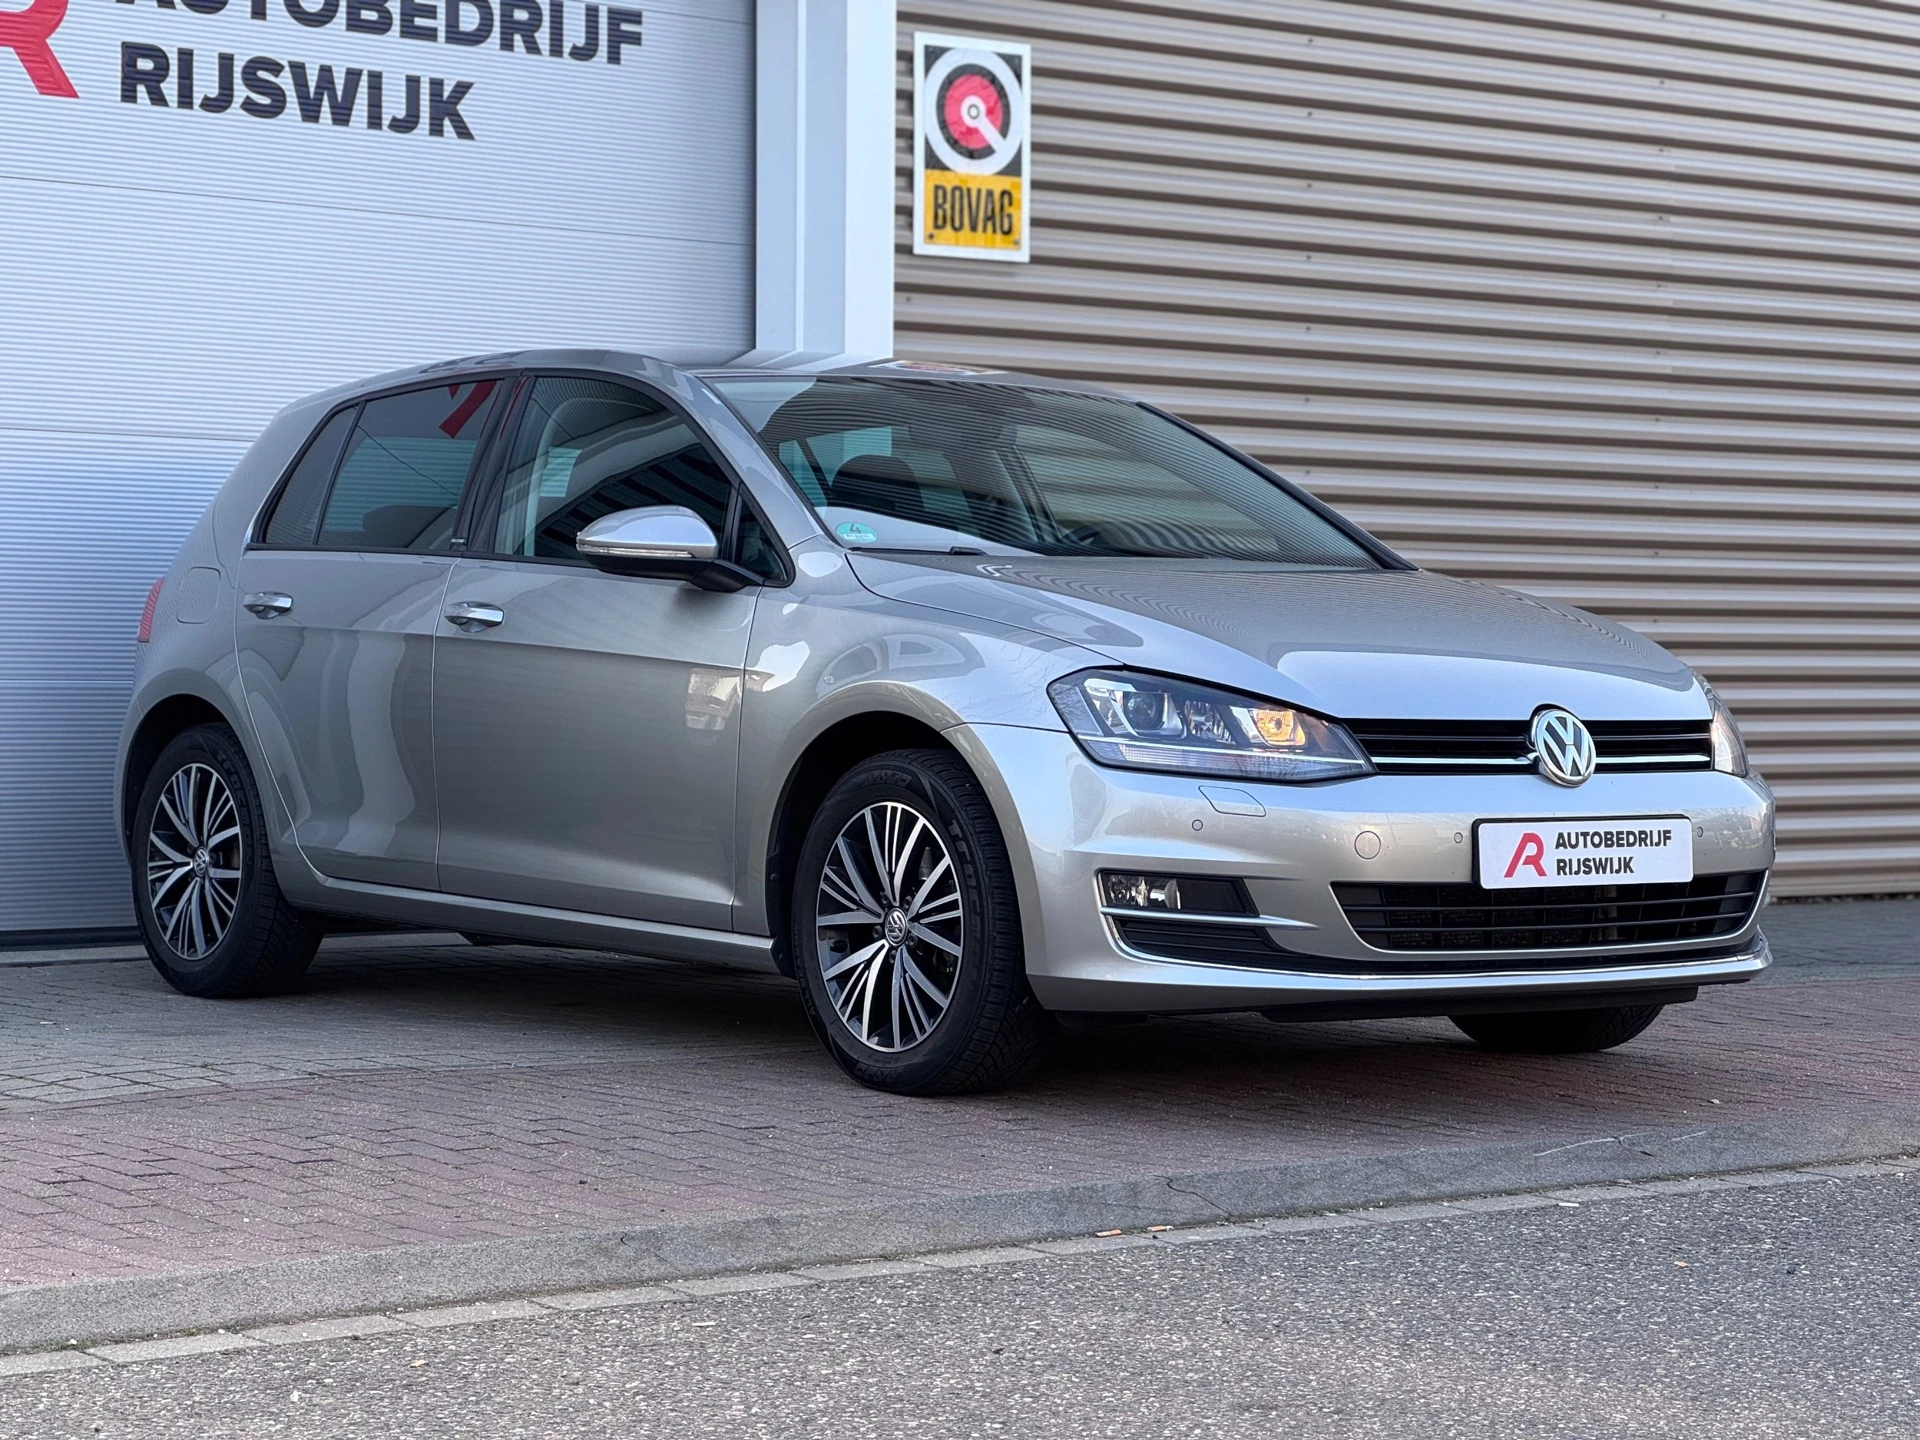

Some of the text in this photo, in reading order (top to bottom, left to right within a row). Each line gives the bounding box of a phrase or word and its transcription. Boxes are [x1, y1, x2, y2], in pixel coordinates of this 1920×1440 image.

[115, 0, 642, 65] BEDRIJF
[120, 41, 476, 140] RIJSWIJK
[933, 184, 1013, 236] BOVAG
[1555, 829, 1672, 850] AUTOBEDRIJF
[1556, 856, 1635, 876] RIJSWIJK
